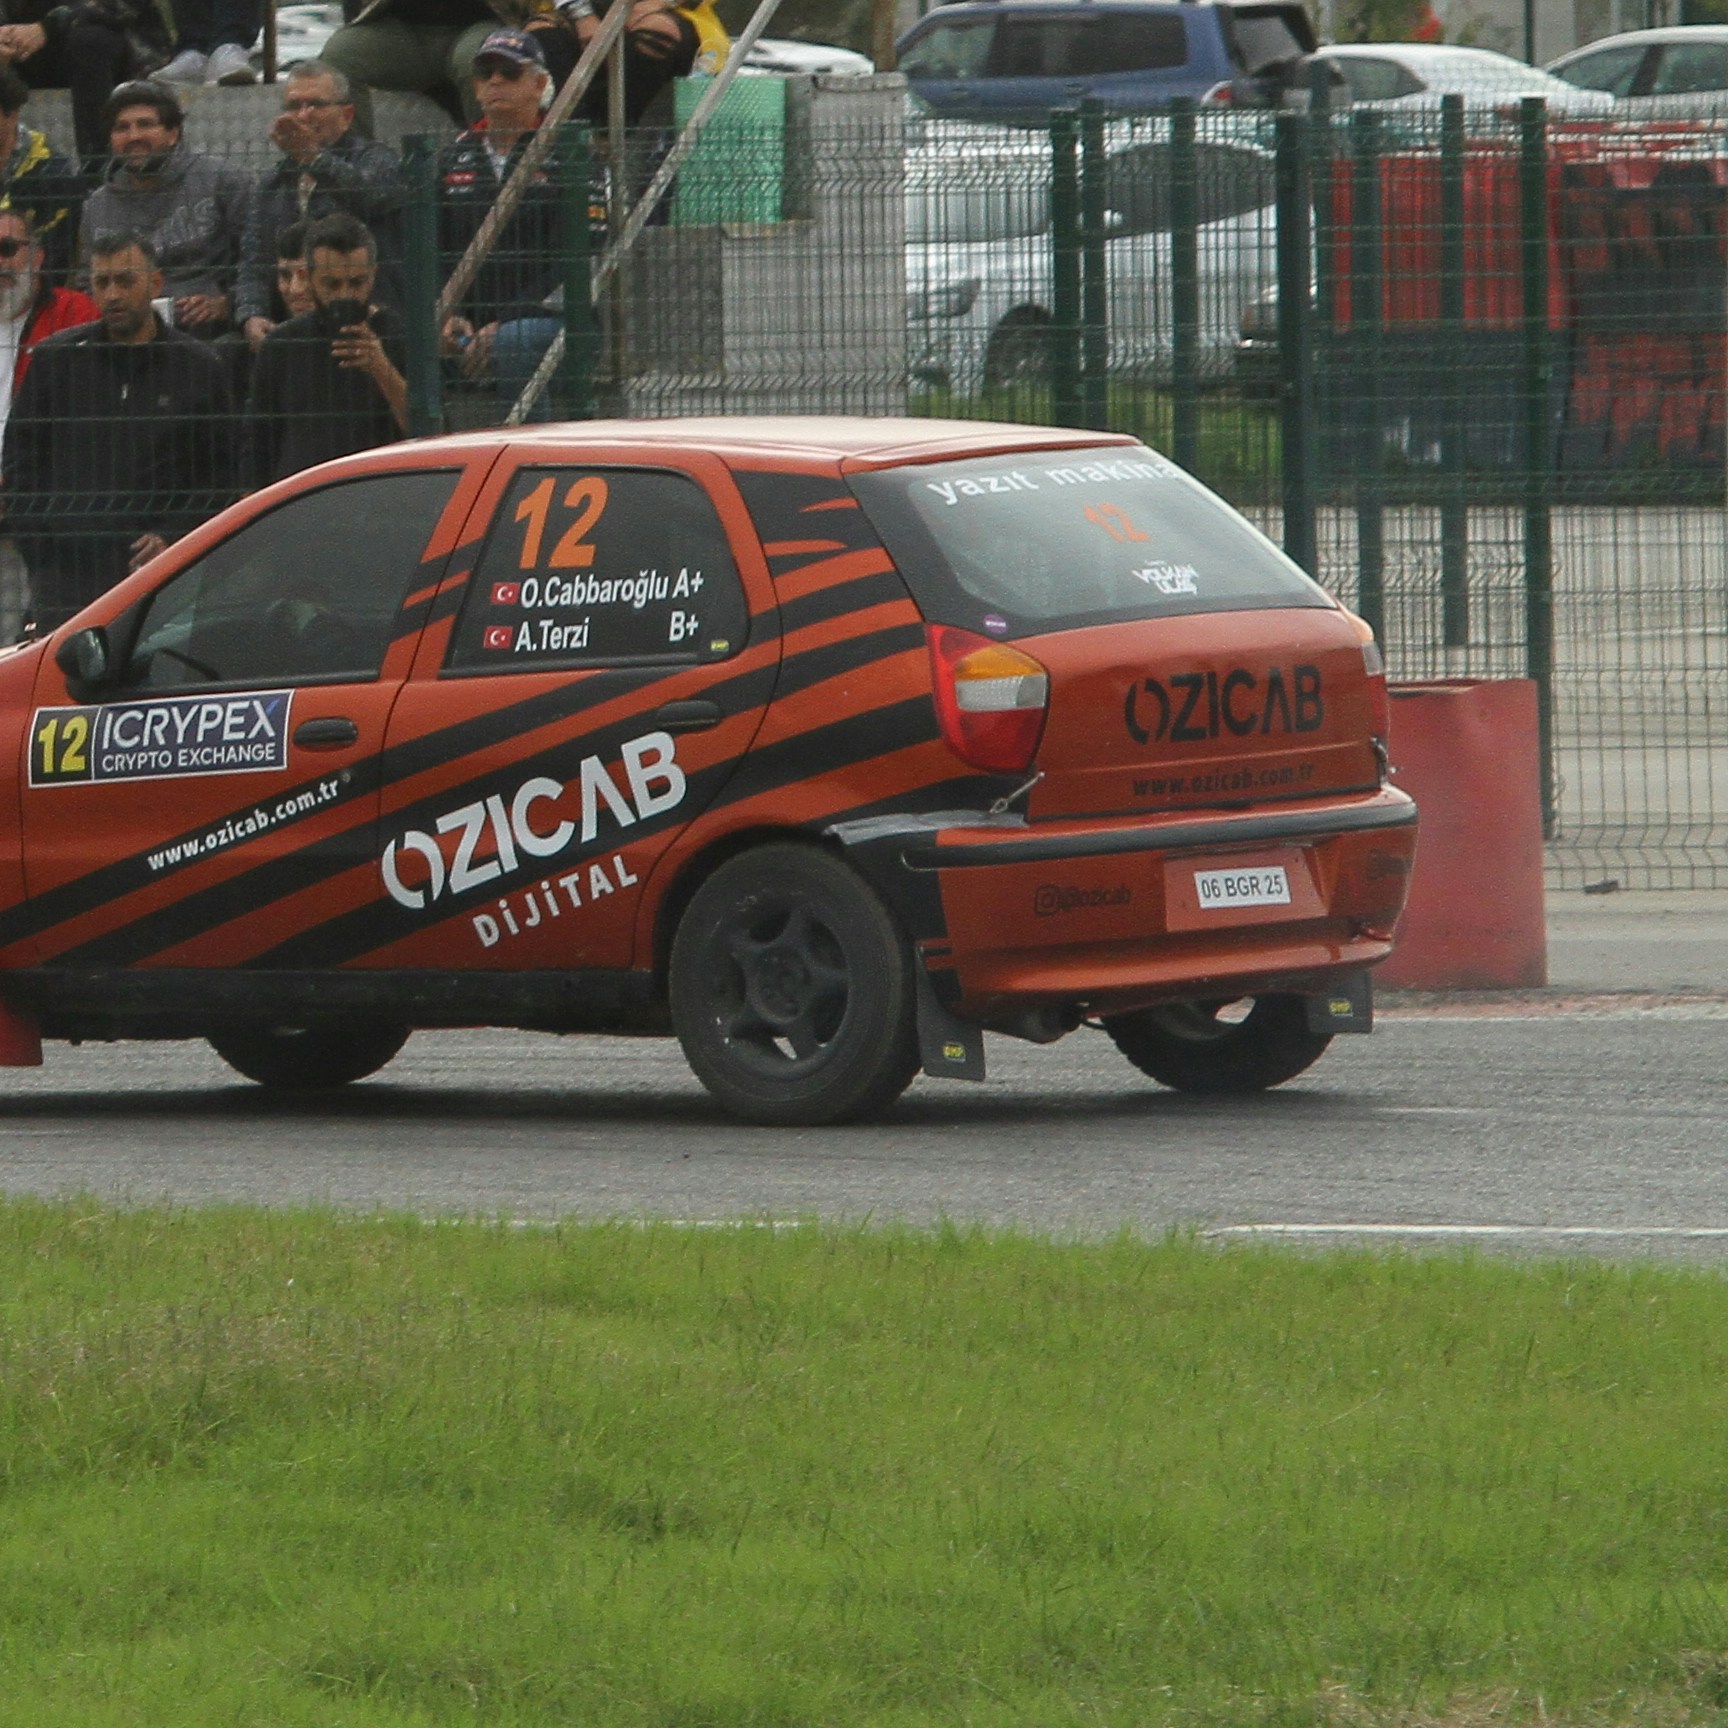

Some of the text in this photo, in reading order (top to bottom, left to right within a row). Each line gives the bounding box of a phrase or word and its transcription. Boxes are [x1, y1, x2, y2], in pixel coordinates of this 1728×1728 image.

[928, 471, 1040, 506] yazıt
[514, 475, 609, 569] 12
[1083, 501, 1150, 543] 12
[520, 567, 705, 609] O.Cabbaroğlu A+
[515, 616, 591, 652] A.Terzi
[669, 610, 700, 642] B+
[102, 699, 281, 750] ICRYPEX
[1124, 664, 1325, 745] OZICAB
[38, 715, 88, 773] 12
[102, 742, 276, 772] CRYPTO EXCHANGE
[1133, 763, 1314, 797] www.ozicab.com.tr
[147, 779, 340, 871] www.ozicab.com.tr
[381, 731, 686, 909] OZICAB
[1200, 874, 1284, 900] 06 BGR 25
